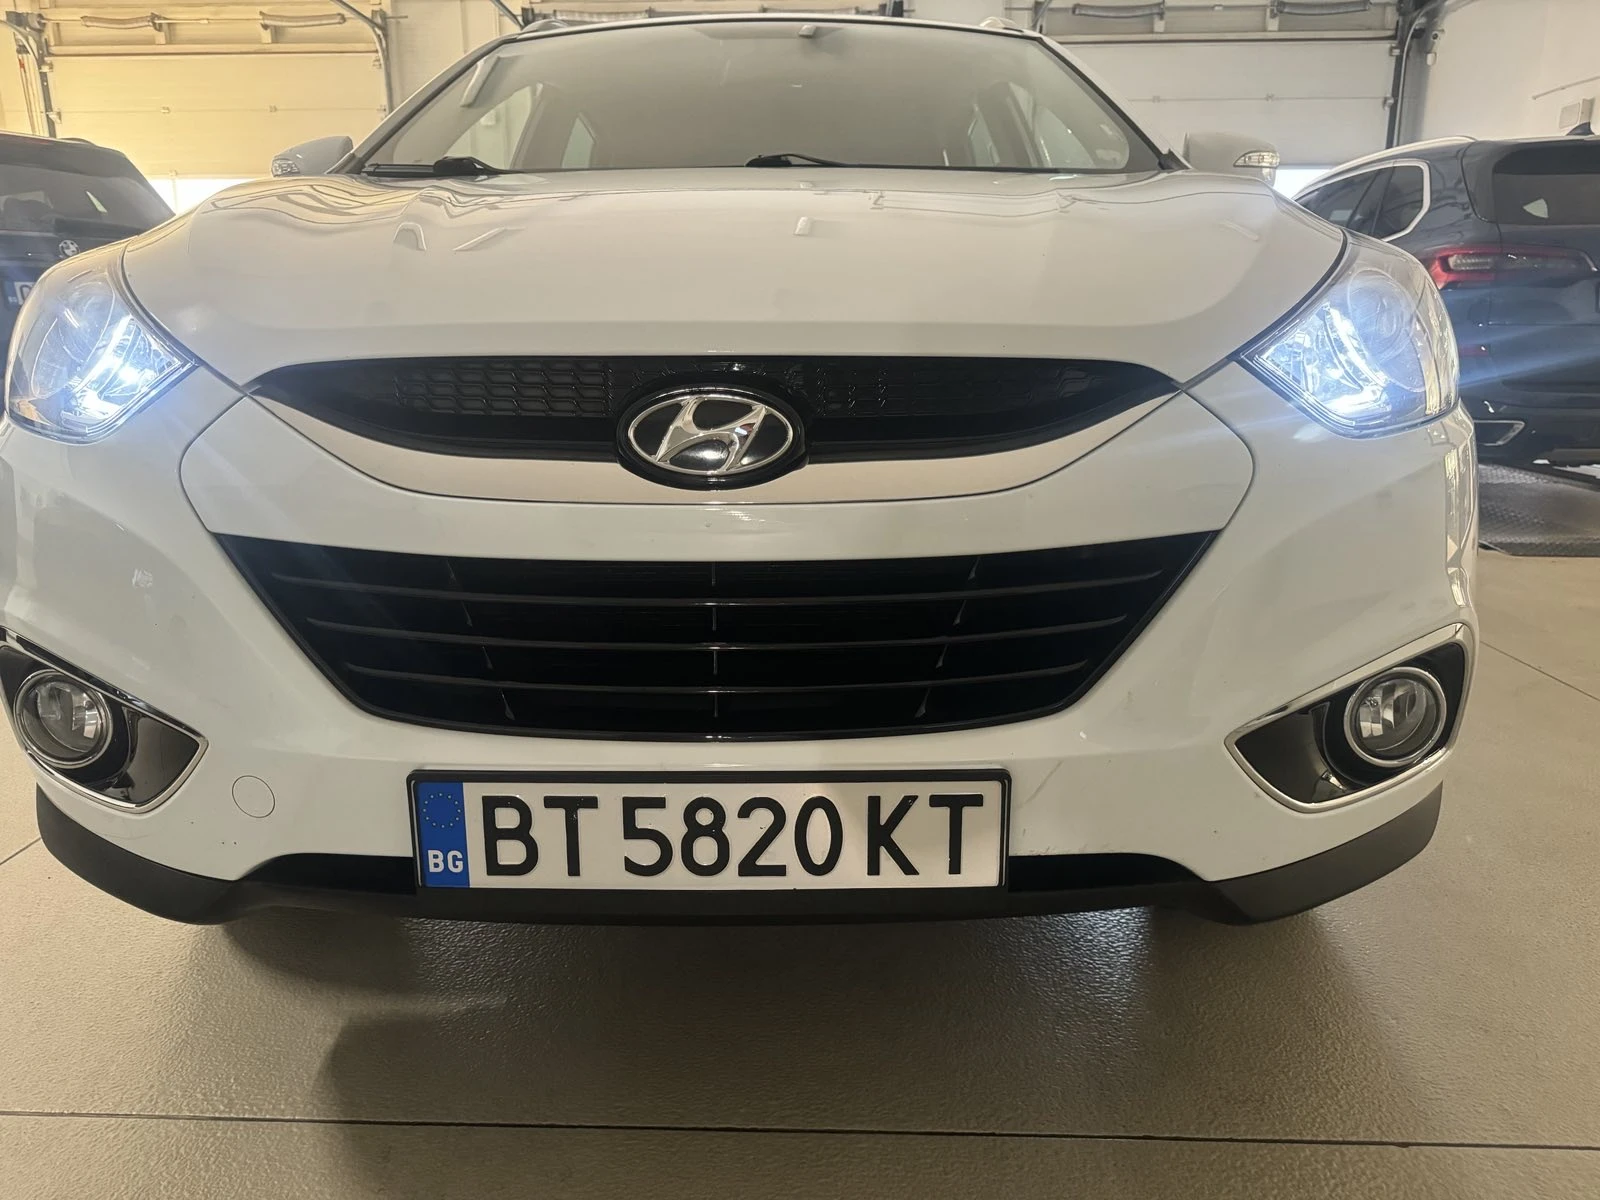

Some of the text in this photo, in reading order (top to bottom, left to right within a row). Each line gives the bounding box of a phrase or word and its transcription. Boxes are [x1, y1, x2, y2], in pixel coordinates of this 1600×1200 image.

[427, 849, 464, 873] BG
[481, 793, 985, 878] BT 5820 KT
